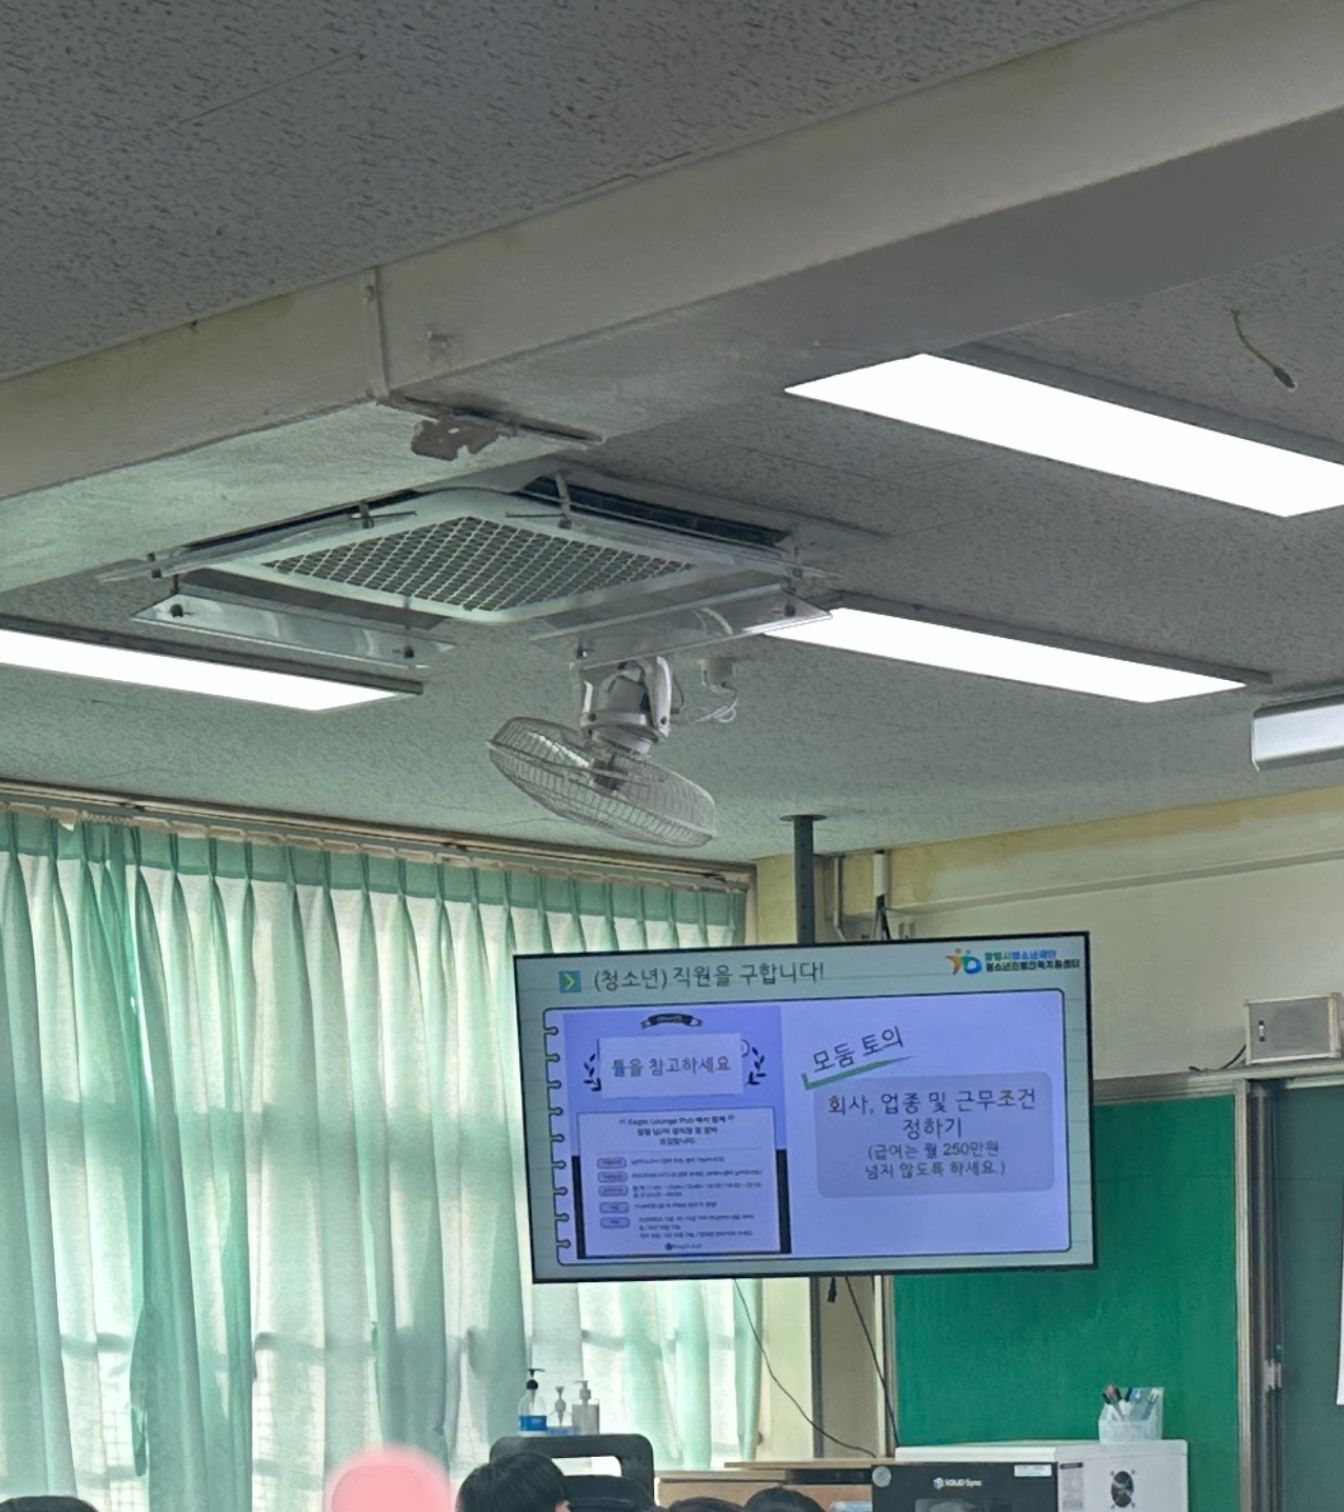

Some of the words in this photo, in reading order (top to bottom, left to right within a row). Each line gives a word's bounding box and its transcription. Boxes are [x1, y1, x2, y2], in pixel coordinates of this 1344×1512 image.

[594, 969, 668, 992] (청소년)
[672, 964, 733, 988] 직원을
[739, 962, 825, 986] 구합니다!
[812, 1043, 856, 1073] 모둠
[861, 1025, 904, 1056] 토의
[649, 1056, 732, 1076] 참고하세요
[828, 1094, 875, 1116] 회사,
[880, 1092, 921, 1115] 업종
[928, 1091, 947, 1113] 및
[956, 1087, 1037, 1112] 근무조건
[902, 1117, 963, 1140] 정하기
[868, 1144, 919, 1161] (급여는
[923, 1143, 938, 1160] 월
[942, 1141, 999, 1158] 250만원
[865, 1164, 894, 1180] 넘지
[899, 1163, 945, 1179] 않도록
[949, 1161, 1006, 1177] 하세요.)
